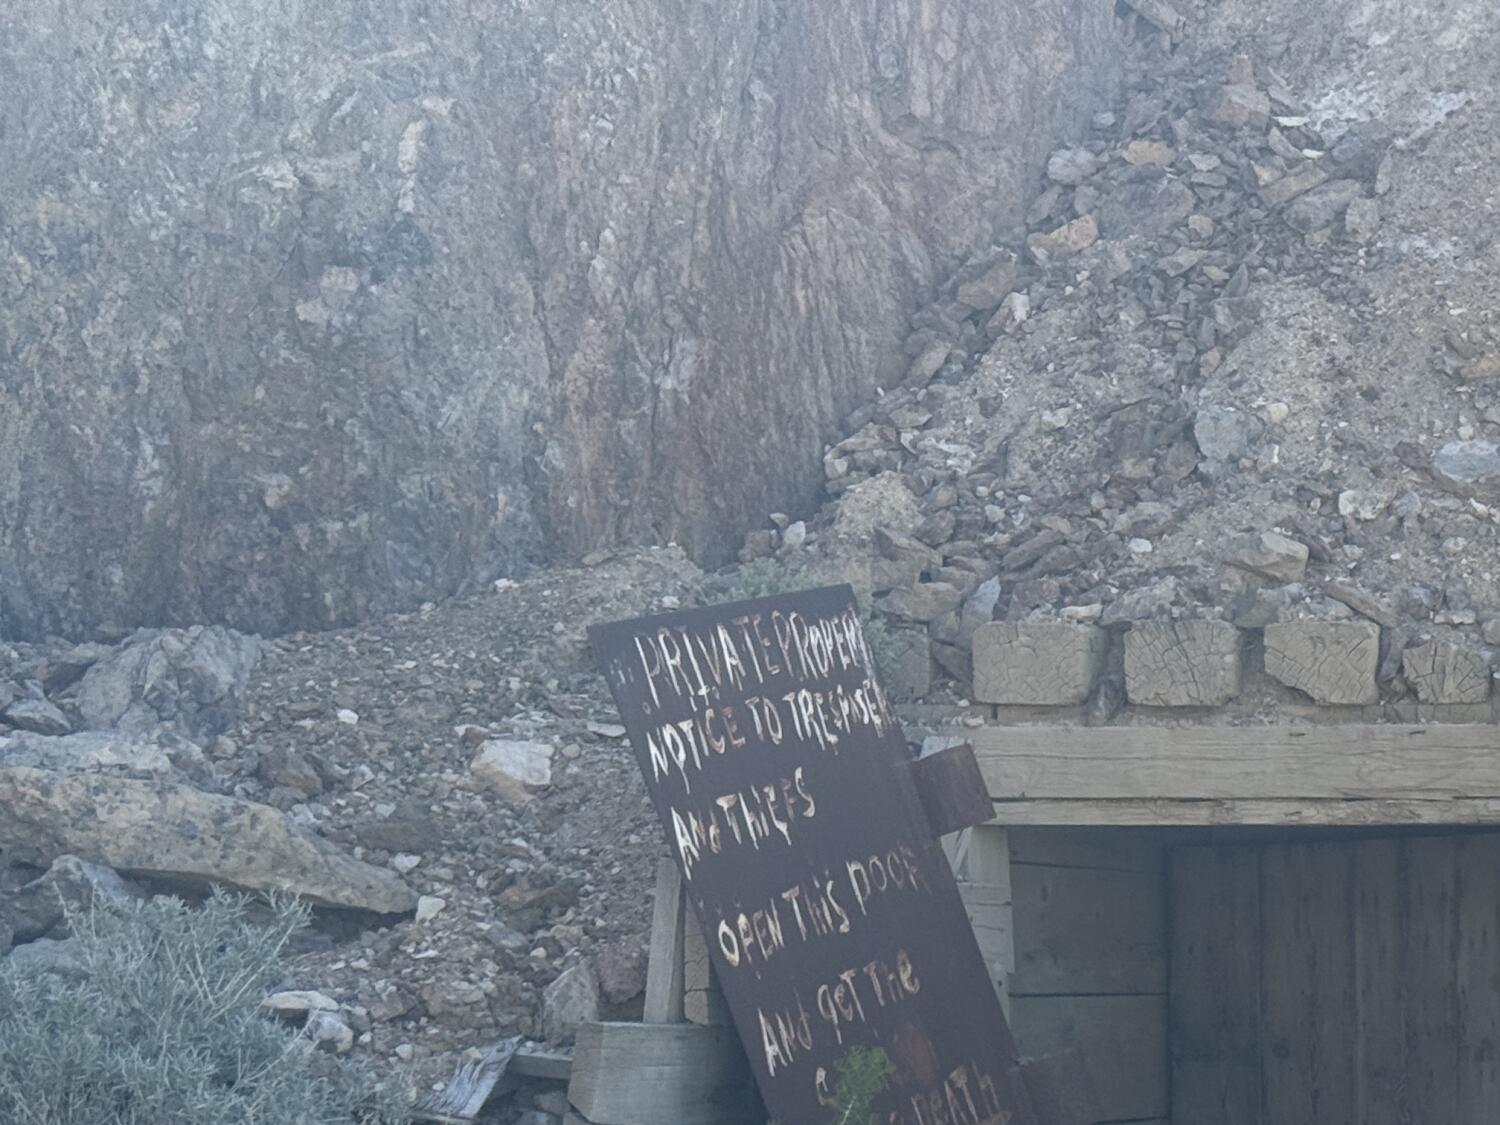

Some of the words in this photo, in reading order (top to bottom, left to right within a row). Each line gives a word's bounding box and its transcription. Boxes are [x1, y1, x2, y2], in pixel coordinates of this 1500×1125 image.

[634, 613, 781, 709] PRIVATE
[646, 704, 746, 793] NOTICE
[746, 696, 783, 745] TO
[718, 897, 784, 968] OPEN
